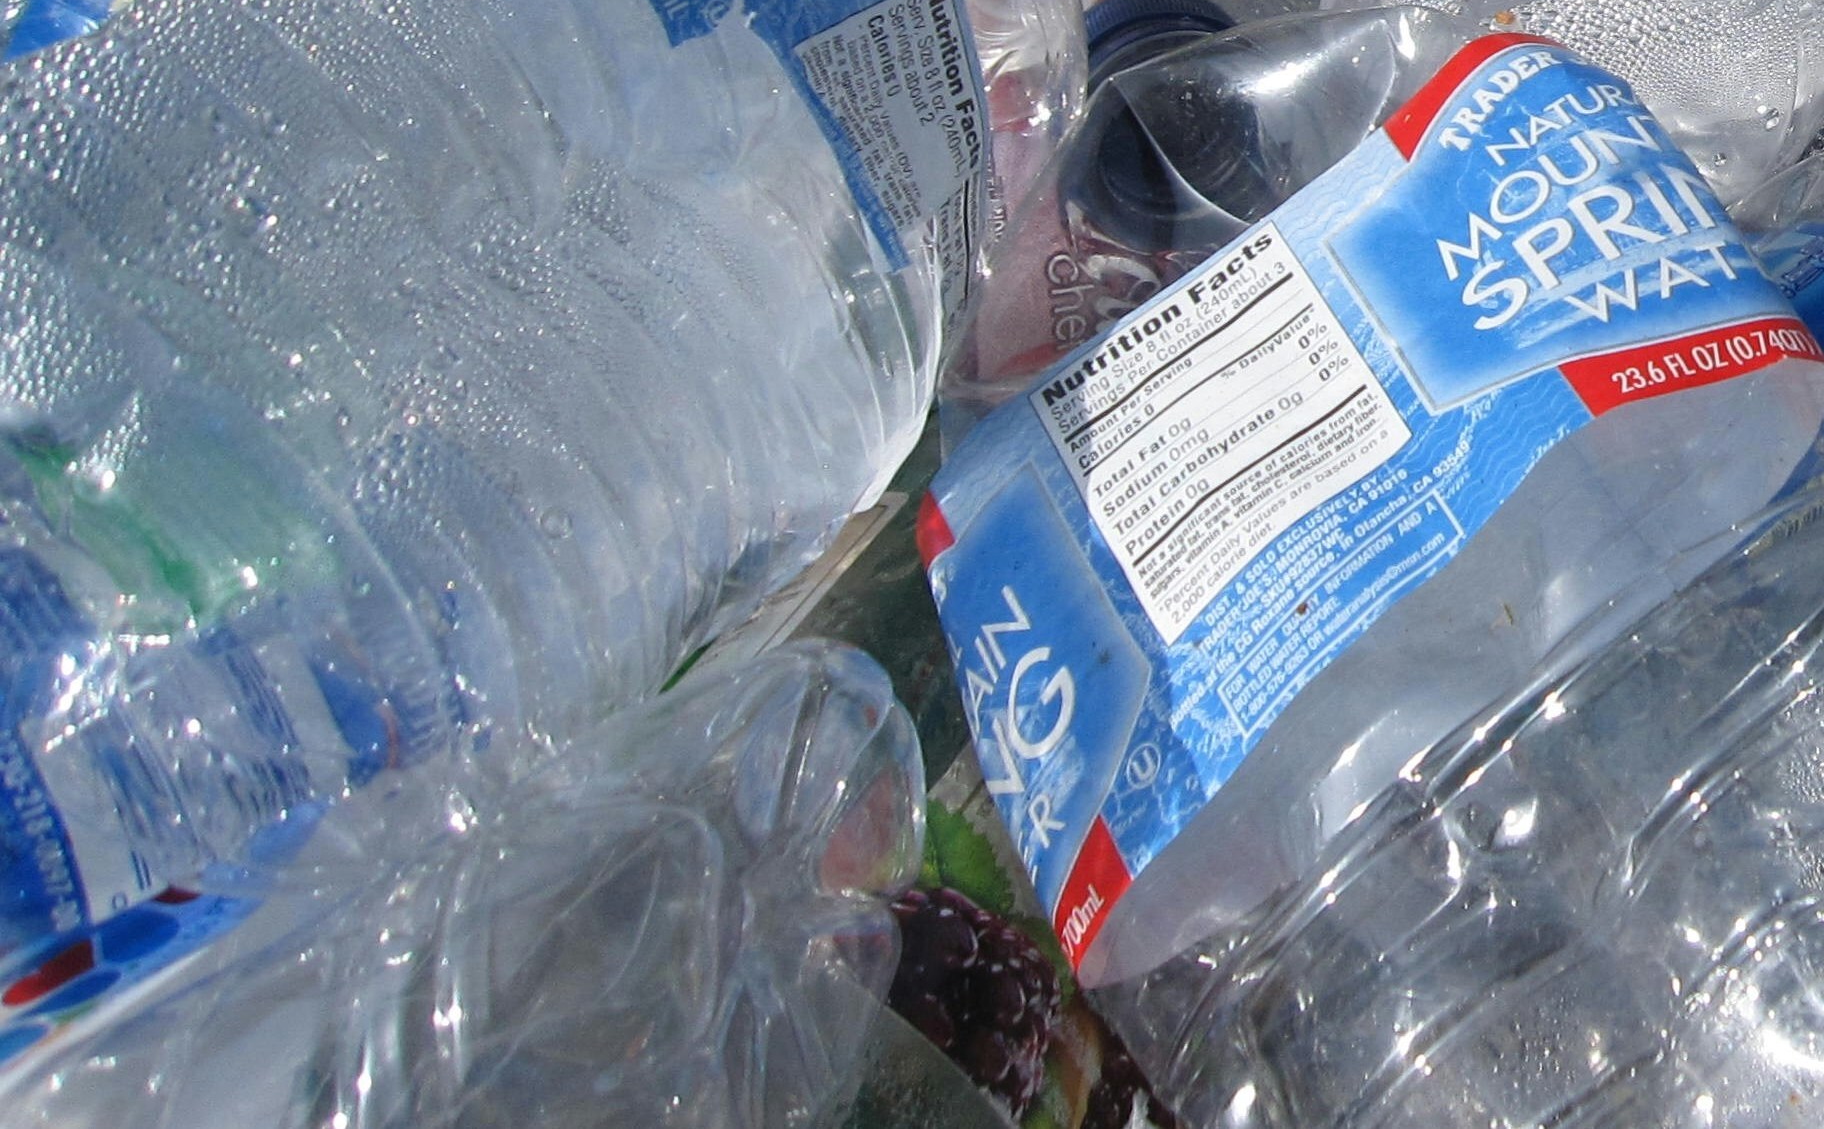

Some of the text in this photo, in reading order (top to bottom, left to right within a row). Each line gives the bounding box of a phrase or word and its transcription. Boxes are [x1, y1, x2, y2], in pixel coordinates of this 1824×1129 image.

[866, 12, 899, 98] Calories 0
[886, 2, 933, 126] Servings about 2
[915, 35, 936, 66] Size
[924, 67, 938, 80] 8
[927, 80, 942, 94] fl
[932, 94, 945, 113] oz
[1437, 50, 1561, 151] TRADER
[954, 98, 986, 169] Facts
[1041, 229, 1273, 406] Nutrition Facts
[1049, 338, 1156, 423] Serving Size 8
[1056, 269, 1274, 436] Servings Per Container about
[1611, 343, 1728, 393] 23.6 FL OZ
[1075, 410, 1143, 469] Calories
[1091, 432, 1166, 498] Total Fat
[1112, 404, 1277, 537] Total Carbohydrate
[1100, 457, 1169, 517] Sodium
[1123, 495, 1185, 554] Protein
